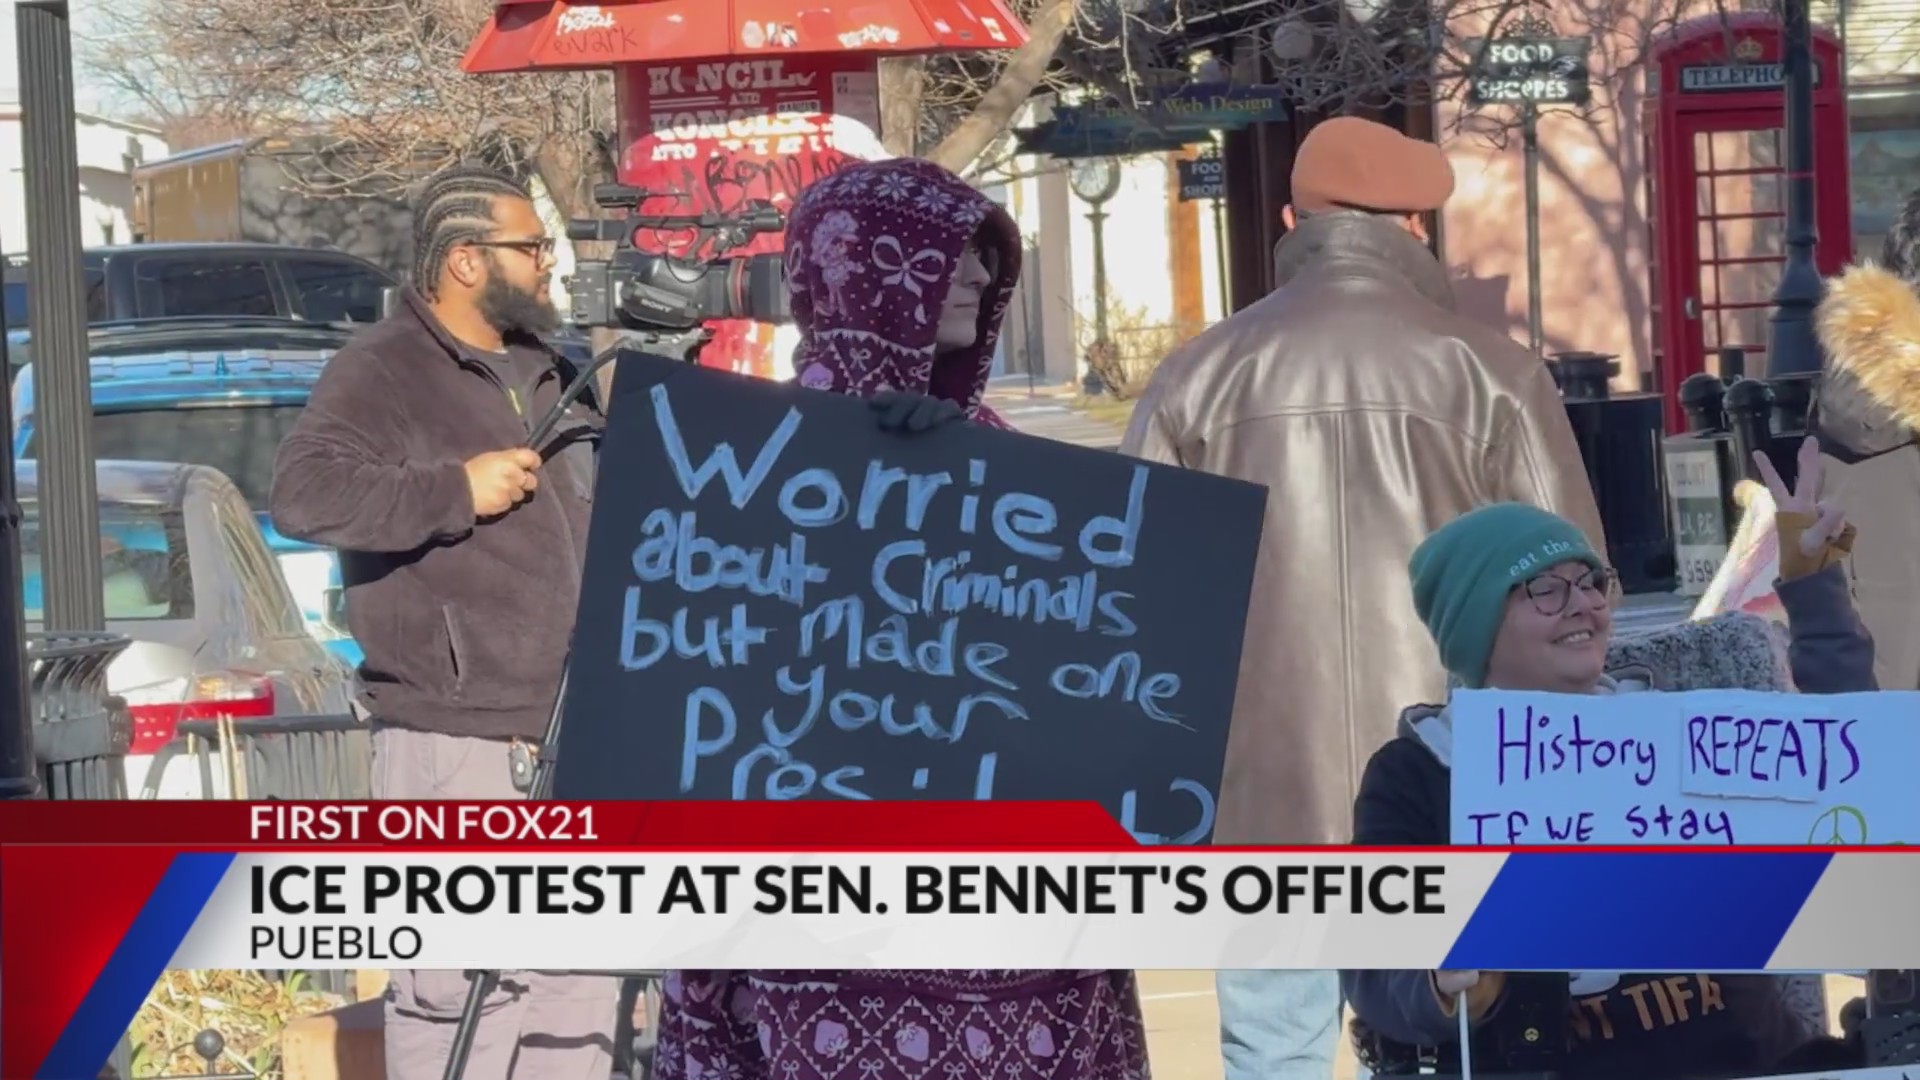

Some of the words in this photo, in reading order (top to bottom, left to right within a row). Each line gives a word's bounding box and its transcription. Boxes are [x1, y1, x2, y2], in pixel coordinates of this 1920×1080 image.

[1490, 44, 1554, 63] FOOD
[1690, 65, 1786, 86] TELEPHO
[1212, 94, 1273, 113] Design
[1191, 162, 1222, 175] FOO
[651, 383, 1149, 567] Worried
[632, 508, 830, 602] about
[872, 539, 1137, 638] Criminals
[1510, 552, 1538, 576] eat
[619, 586, 778, 671] but
[1048, 650, 1198, 732] one
[762, 664, 1030, 746] your
[1498, 705, 1657, 786] History
[1688, 715, 1861, 792] REPEATS
[1621, 975, 1725, 1031] TIFA
